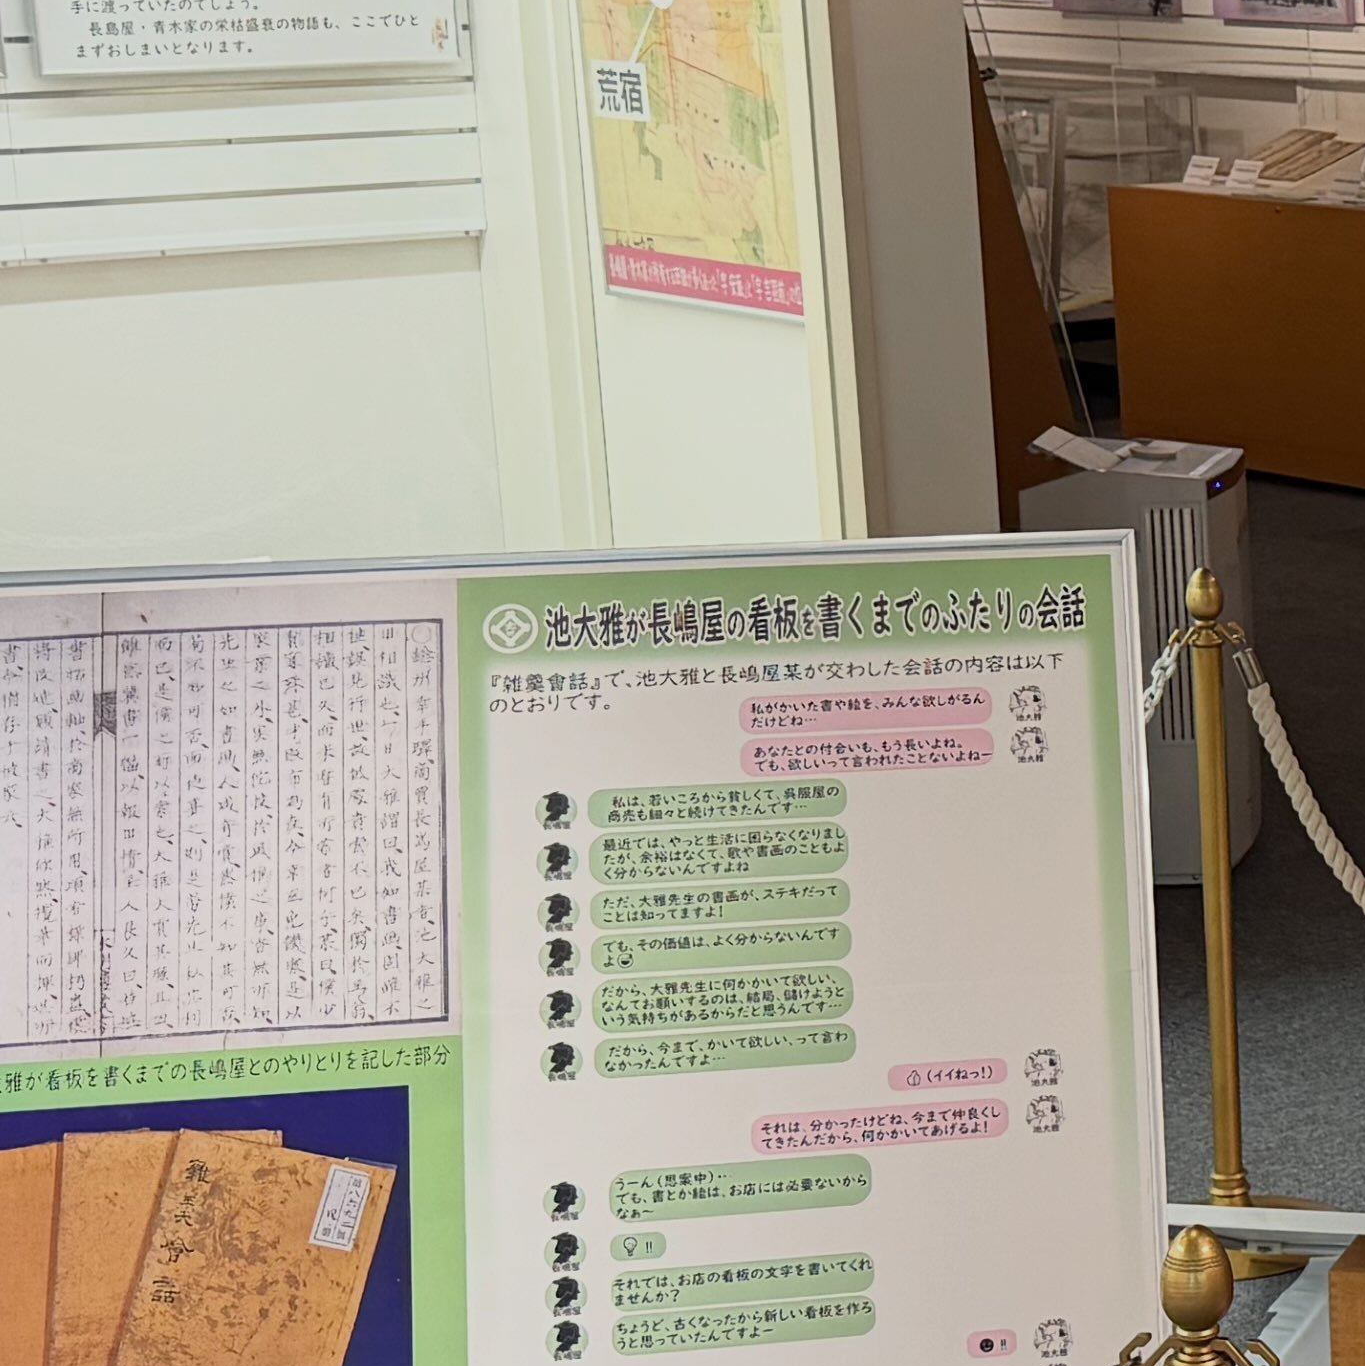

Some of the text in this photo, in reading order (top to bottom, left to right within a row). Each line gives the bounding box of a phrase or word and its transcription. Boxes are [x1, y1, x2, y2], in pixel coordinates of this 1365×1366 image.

[597, 66, 644, 115] 荒宿
[544, 584, 1086, 649] 池大雅が長嶋屋の看板を書くまでのふたりの会話
[489, 695, 613, 713] のとおりです。
[0, 1043, 450, 1093] 雅が看板を書くまでの長嶋屋とのやりとりを記した部分
